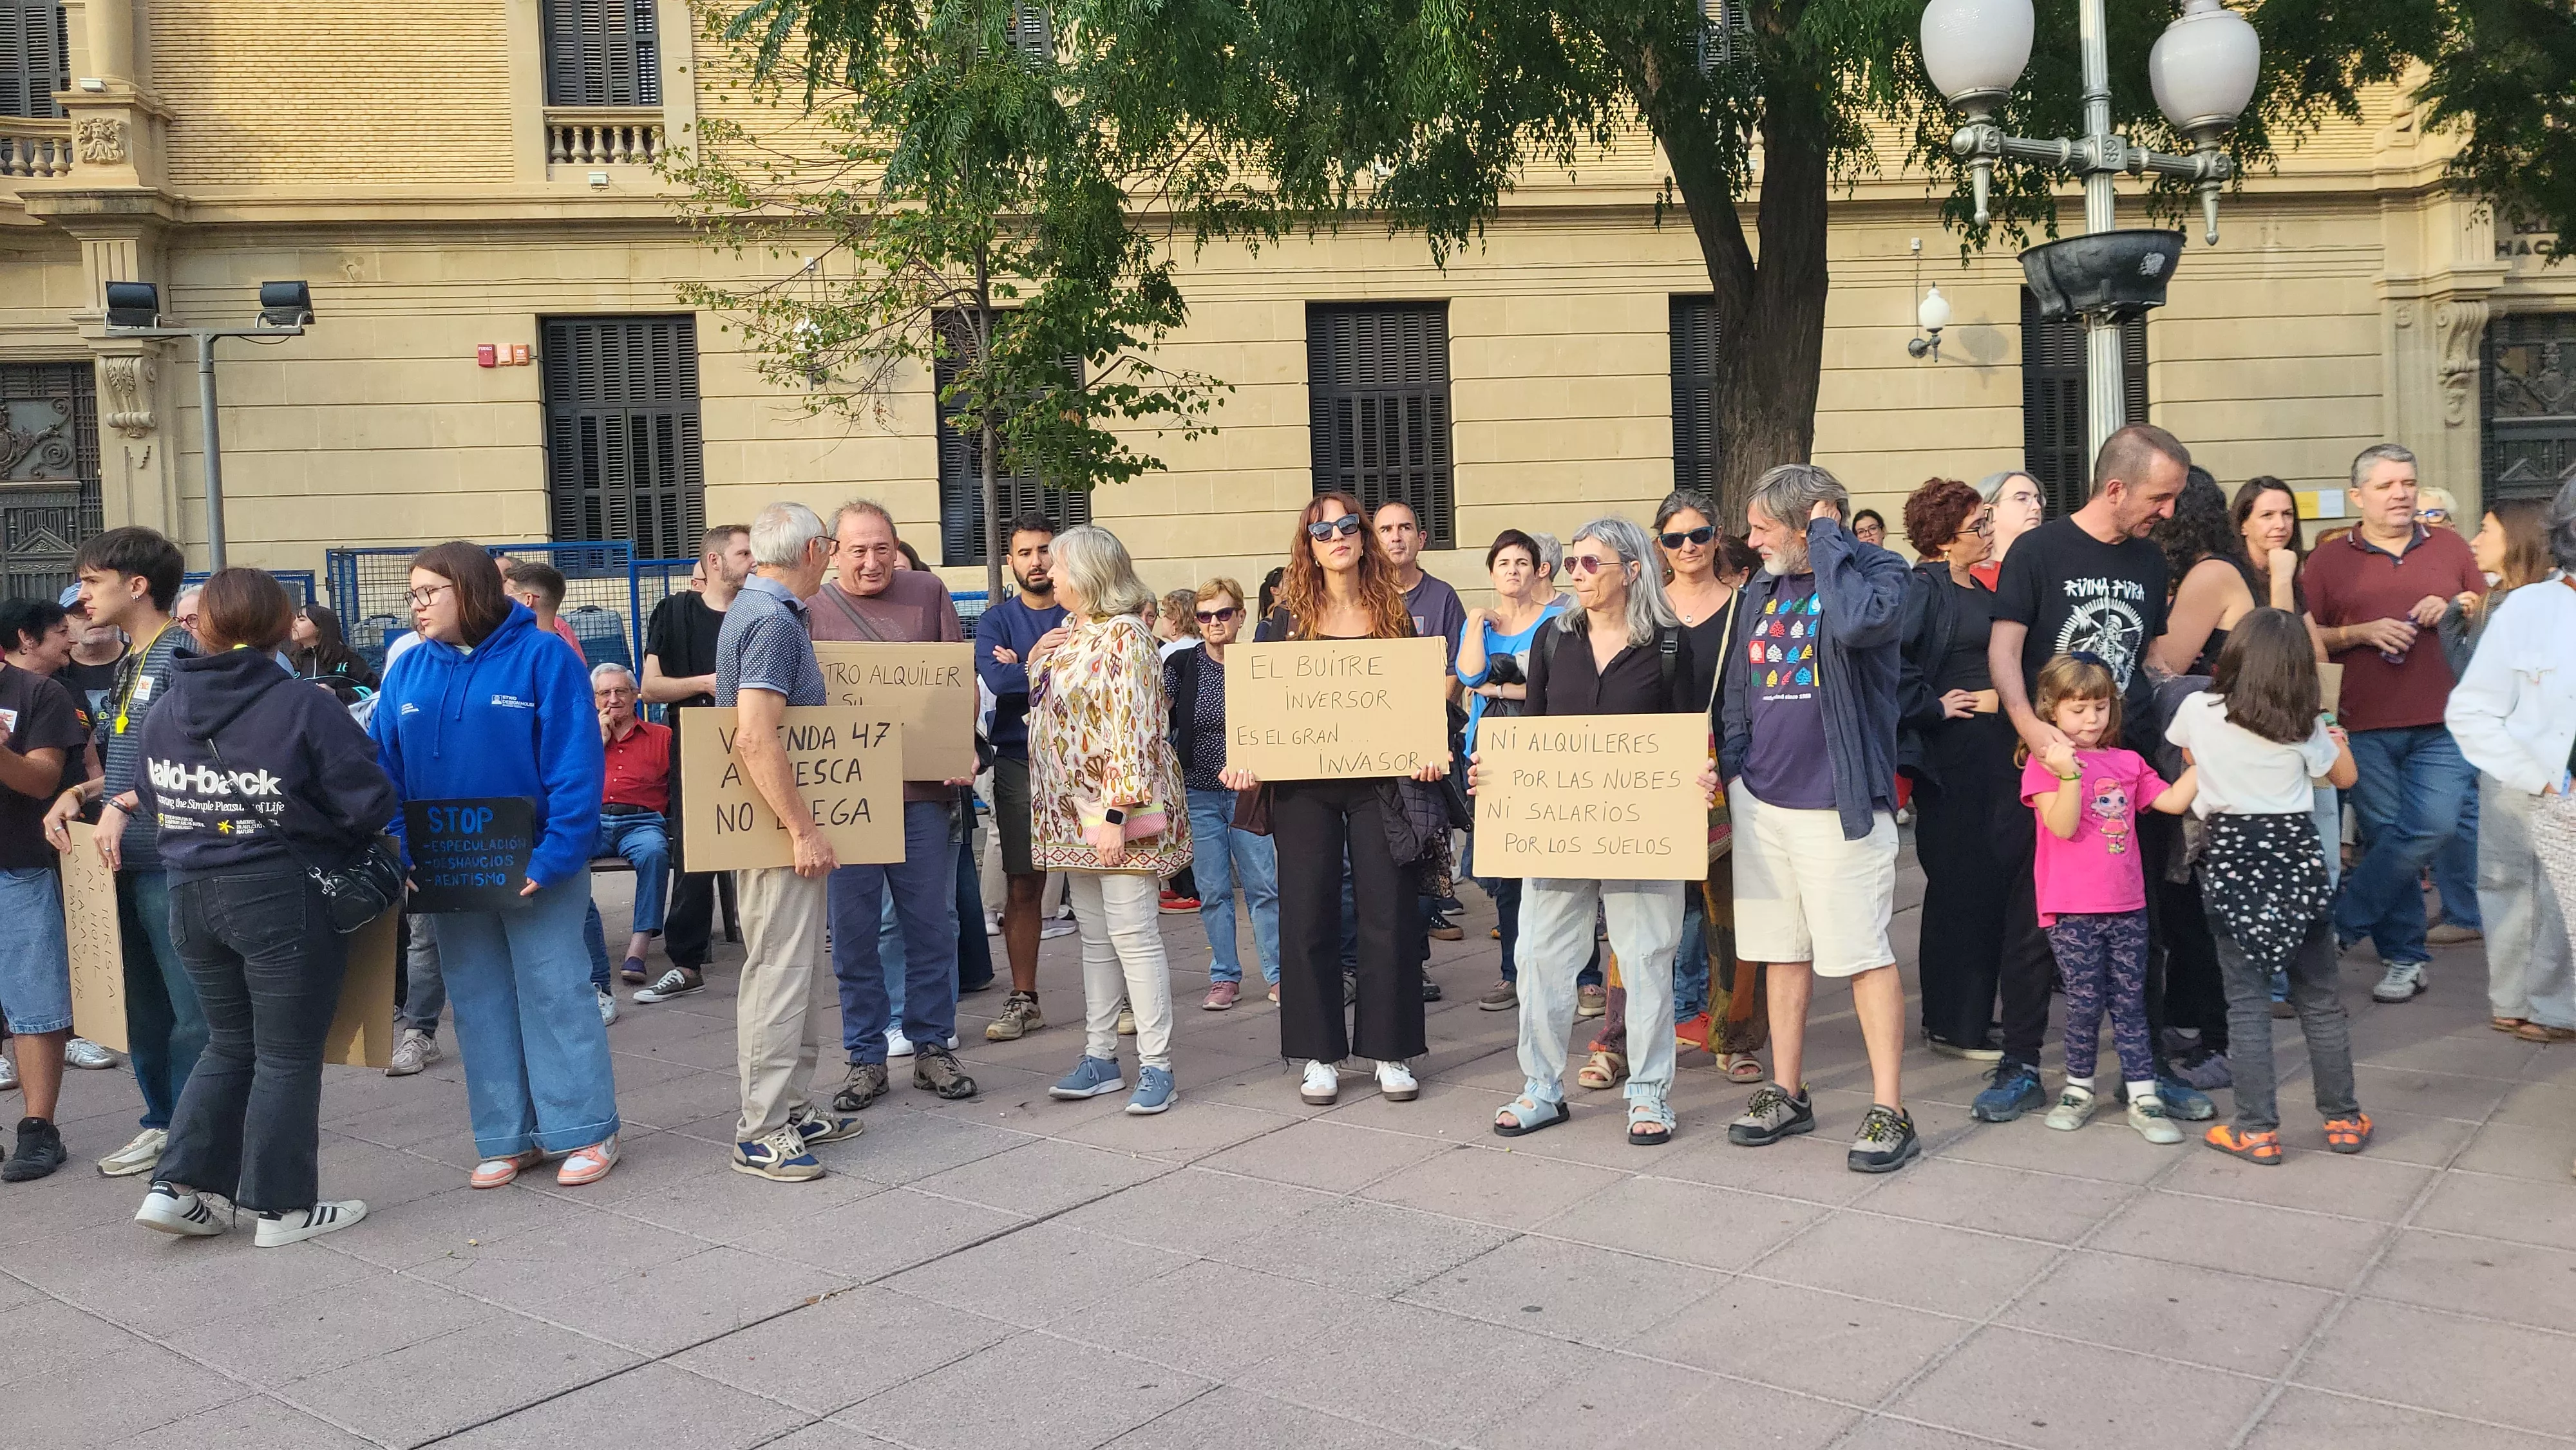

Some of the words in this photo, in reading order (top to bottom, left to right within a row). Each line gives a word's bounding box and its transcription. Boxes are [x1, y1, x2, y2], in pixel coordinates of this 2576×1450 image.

[2495, 240, 2559, 256] HAC
[1251, 655, 1283, 679] EL
[852, 722, 891, 749] 47
[1266, 730, 1285, 745] EL
[1293, 722, 1338, 745] GRAN
[721, 762, 742, 788] A
[1513, 769, 1548, 788] POR
[1558, 770, 1593, 789] LAS
[1603, 768, 1681, 789] NUBES
[176, 798, 187, 808] the
[187, 799, 214, 813] Simple
[214, 801, 254, 811] Pleasu
[255, 802, 265, 813] of
[265, 801, 285, 815] Life
[716, 802, 753, 834] NO
[427, 806, 493, 834] STOP
[1506, 833, 1542, 855] POR
[1548, 836, 1582, 853] LOS
[1592, 836, 1672, 855] SUELOS
[90, 912, 100, 979] HOTEL
